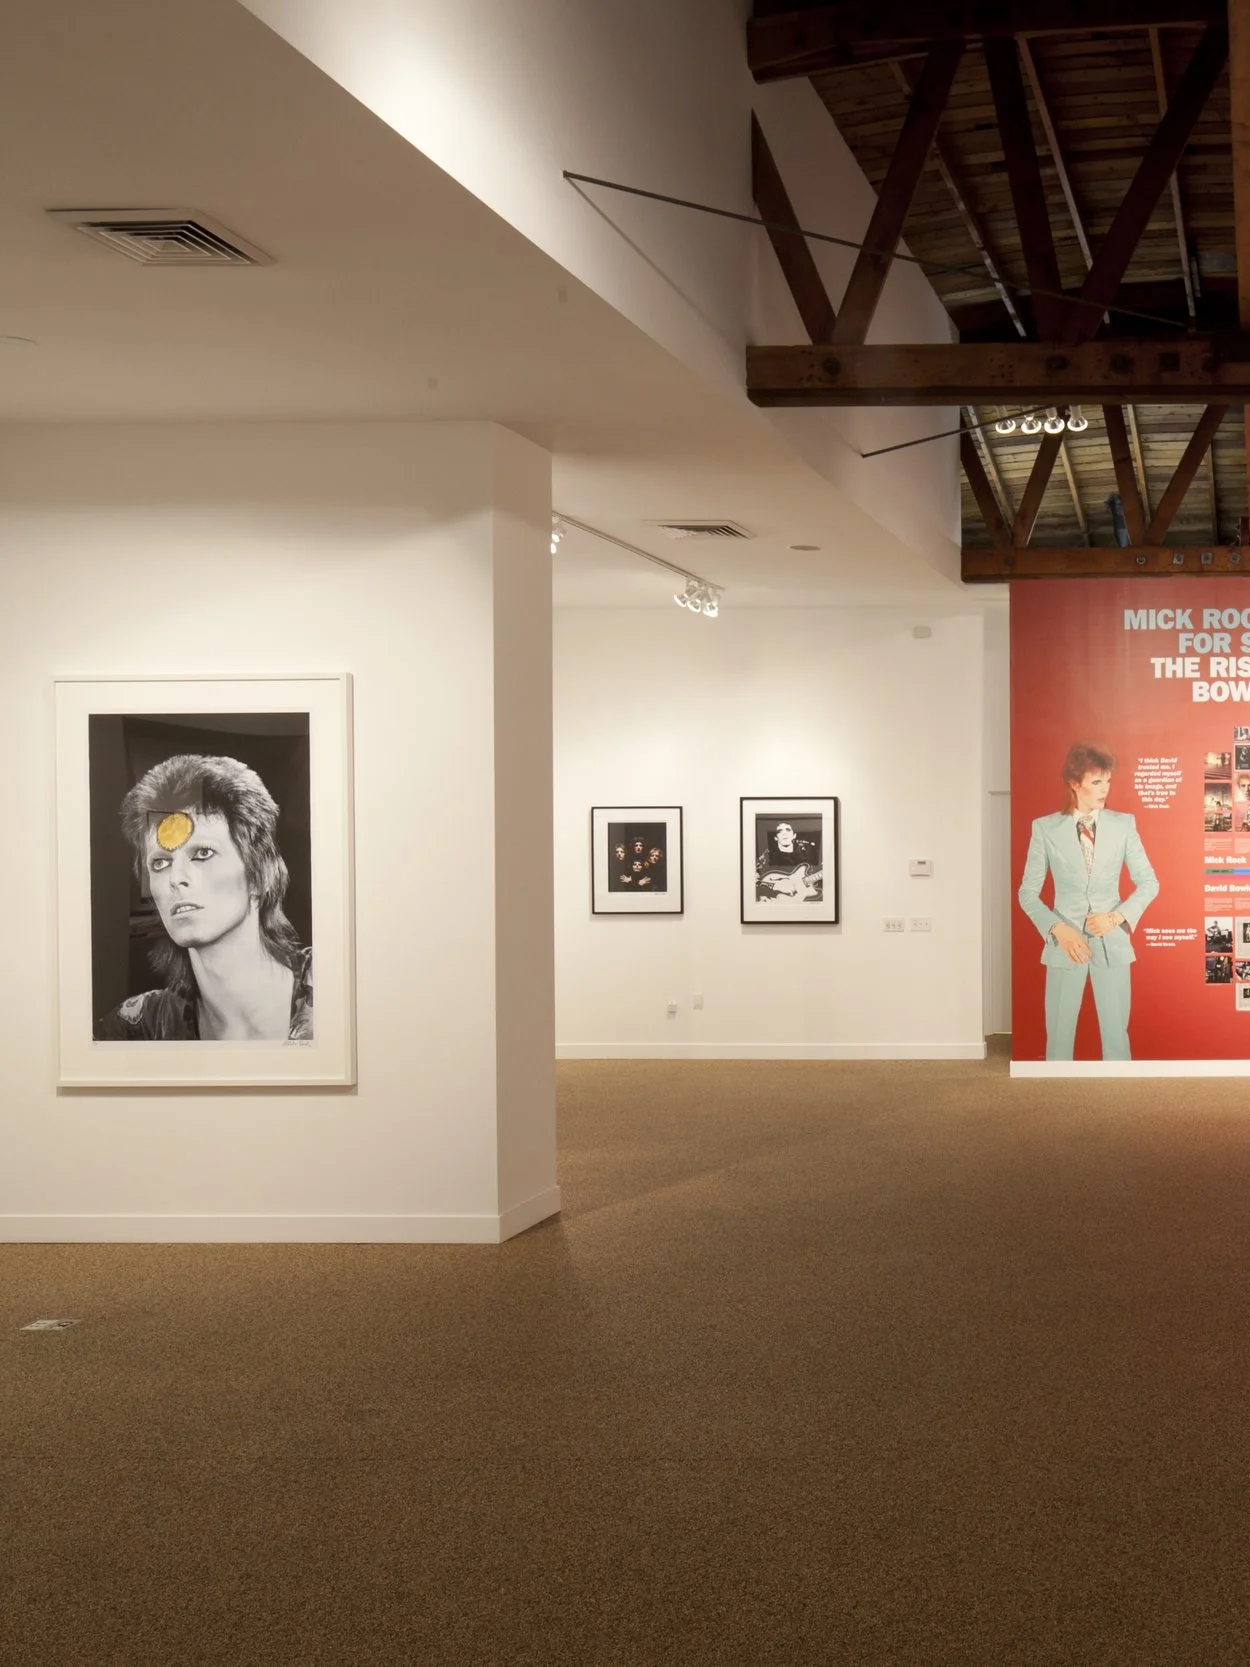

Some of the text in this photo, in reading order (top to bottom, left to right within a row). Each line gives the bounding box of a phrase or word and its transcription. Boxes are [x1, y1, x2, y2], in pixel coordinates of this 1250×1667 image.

[1124, 609, 1194, 630] MICK
[1179, 632, 1231, 654] FOR
[1150, 657, 1200, 678] THE
[1204, 856, 1247, 864] Mick Rock
[1204, 884, 1227, 892] David
